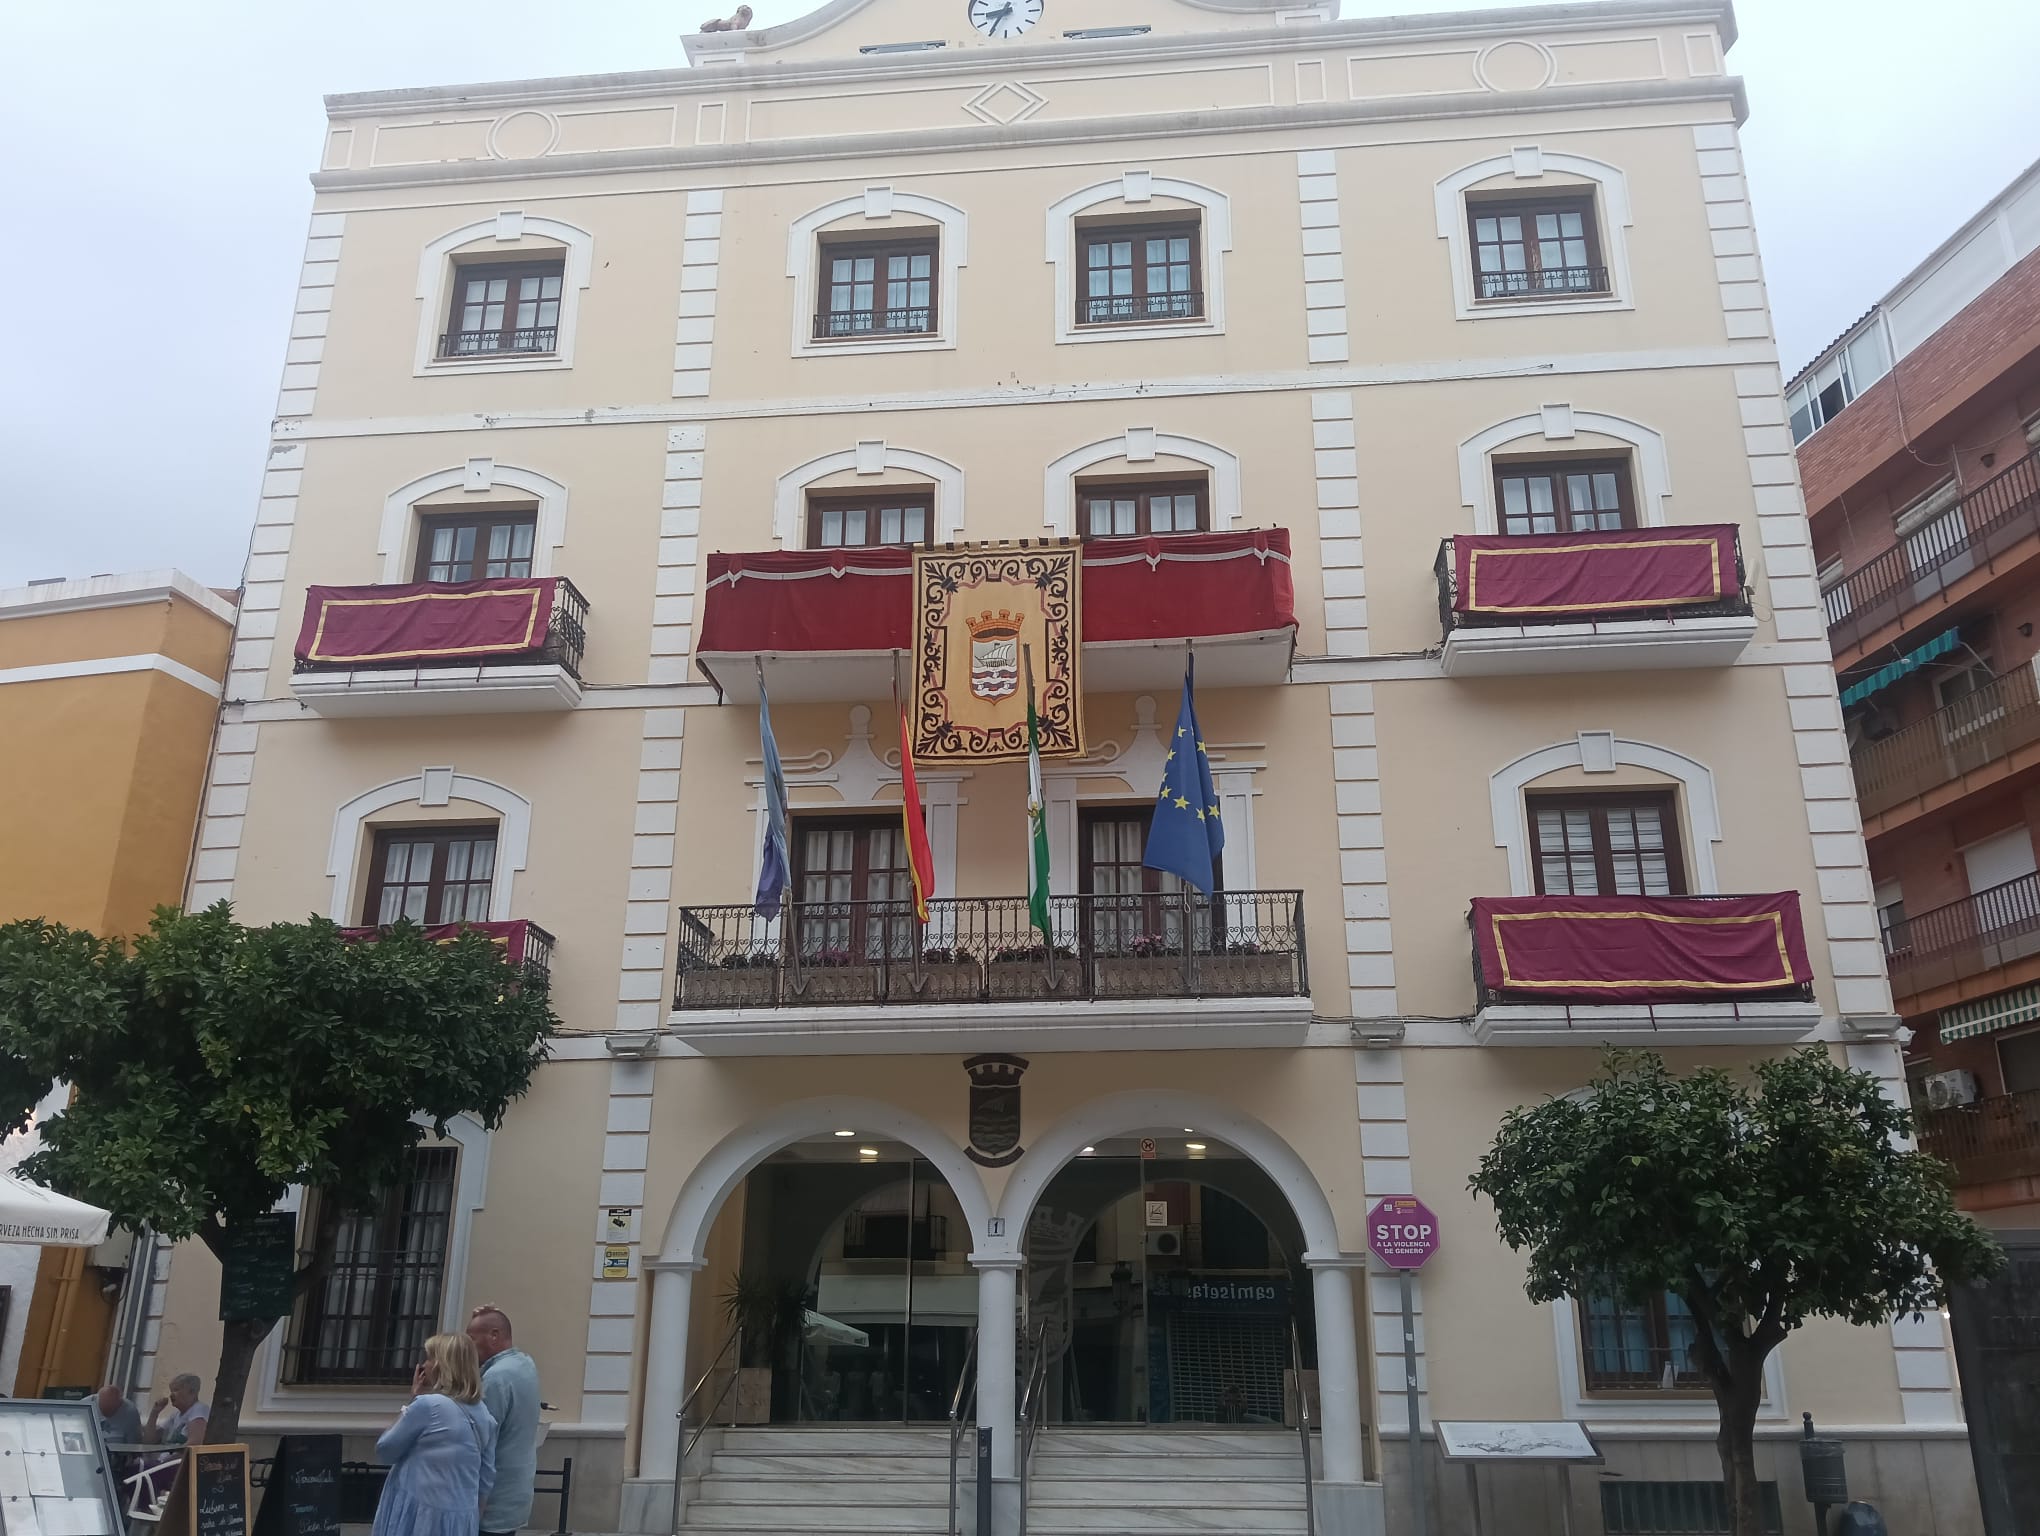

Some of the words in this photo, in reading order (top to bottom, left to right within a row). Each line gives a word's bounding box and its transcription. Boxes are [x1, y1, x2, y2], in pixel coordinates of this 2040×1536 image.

[22, 1225, 44, 1238] HECHA
[60, 1228, 79, 1240] PRISA
[994, 1221, 999, 1233] 1
[1376, 1224, 1431, 1240] STOP
